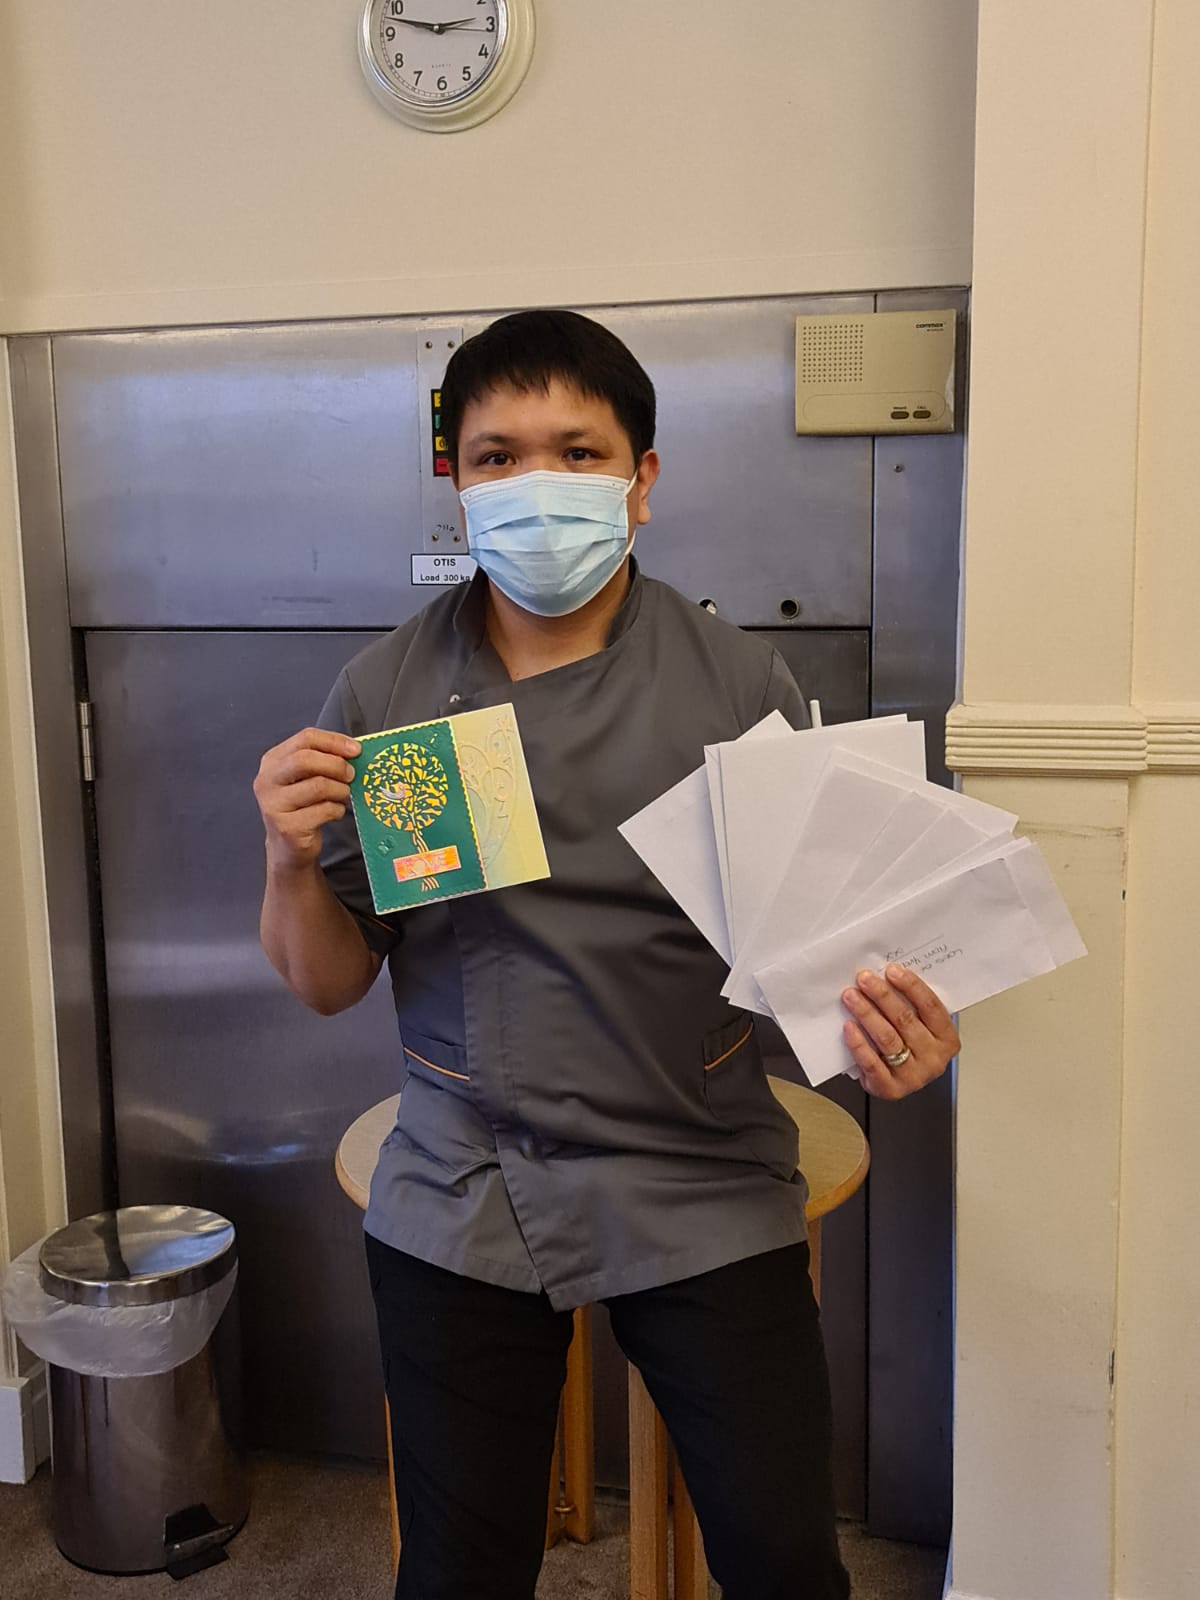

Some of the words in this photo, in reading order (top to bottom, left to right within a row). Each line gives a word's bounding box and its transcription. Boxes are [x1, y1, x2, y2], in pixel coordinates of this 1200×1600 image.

[391, 0, 404, 16] 10
[486, 16, 495, 33] 3
[385, 26, 396, 42] 9
[478, 44, 489, 59] 4
[394, 53, 404, 68] 8
[413, 70, 424, 87] 7
[462, 66, 472, 82] 5
[436, 76, 448, 91] 6
[433, 558, 457, 567] OTIS
[420, 573, 440, 582] Load
[443, 574, 459, 582] 300
[460, 573, 471, 582] kg
